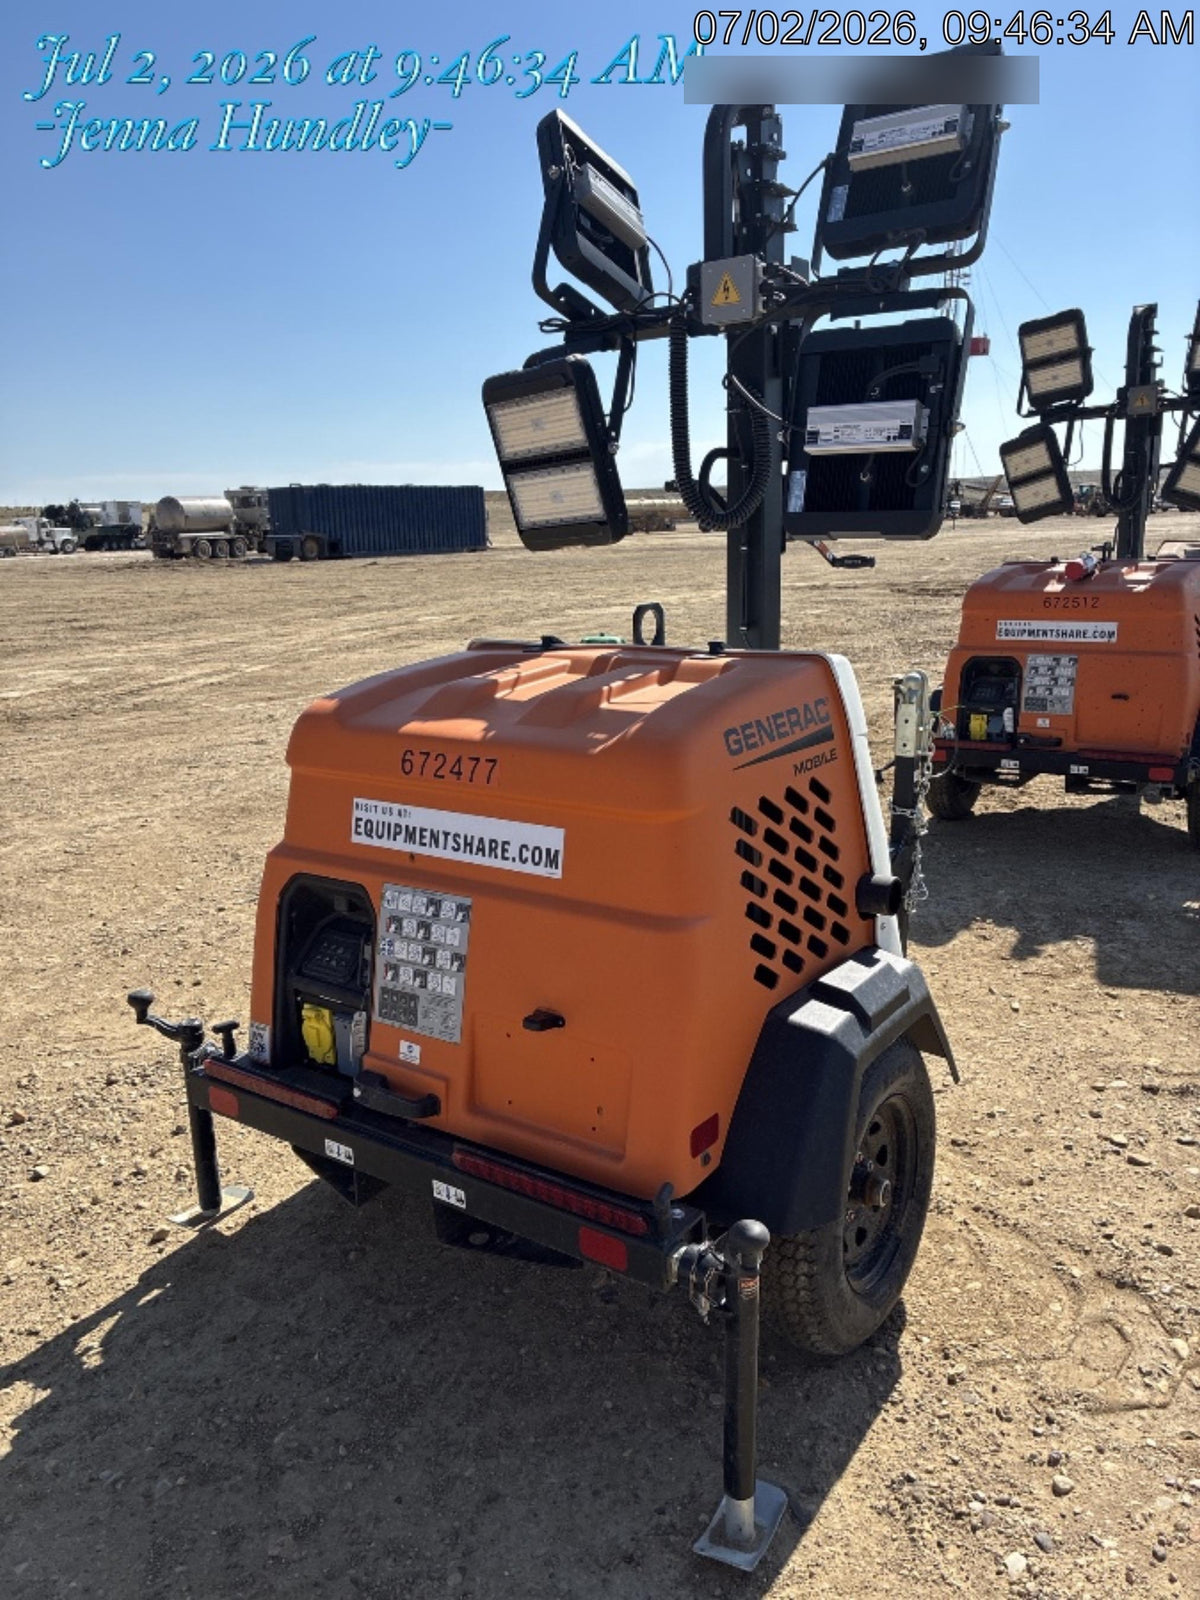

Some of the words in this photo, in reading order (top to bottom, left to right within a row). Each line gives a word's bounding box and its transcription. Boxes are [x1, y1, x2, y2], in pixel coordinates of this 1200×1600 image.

[1043, 597, 1100, 609] 672512
[723, 697, 830, 756] GENERAC
[401, 749, 498, 784] 672477
[792, 748, 838, 776] MOBILE
[354, 817, 560, 870] EQUIPMENTSHARE.COM
